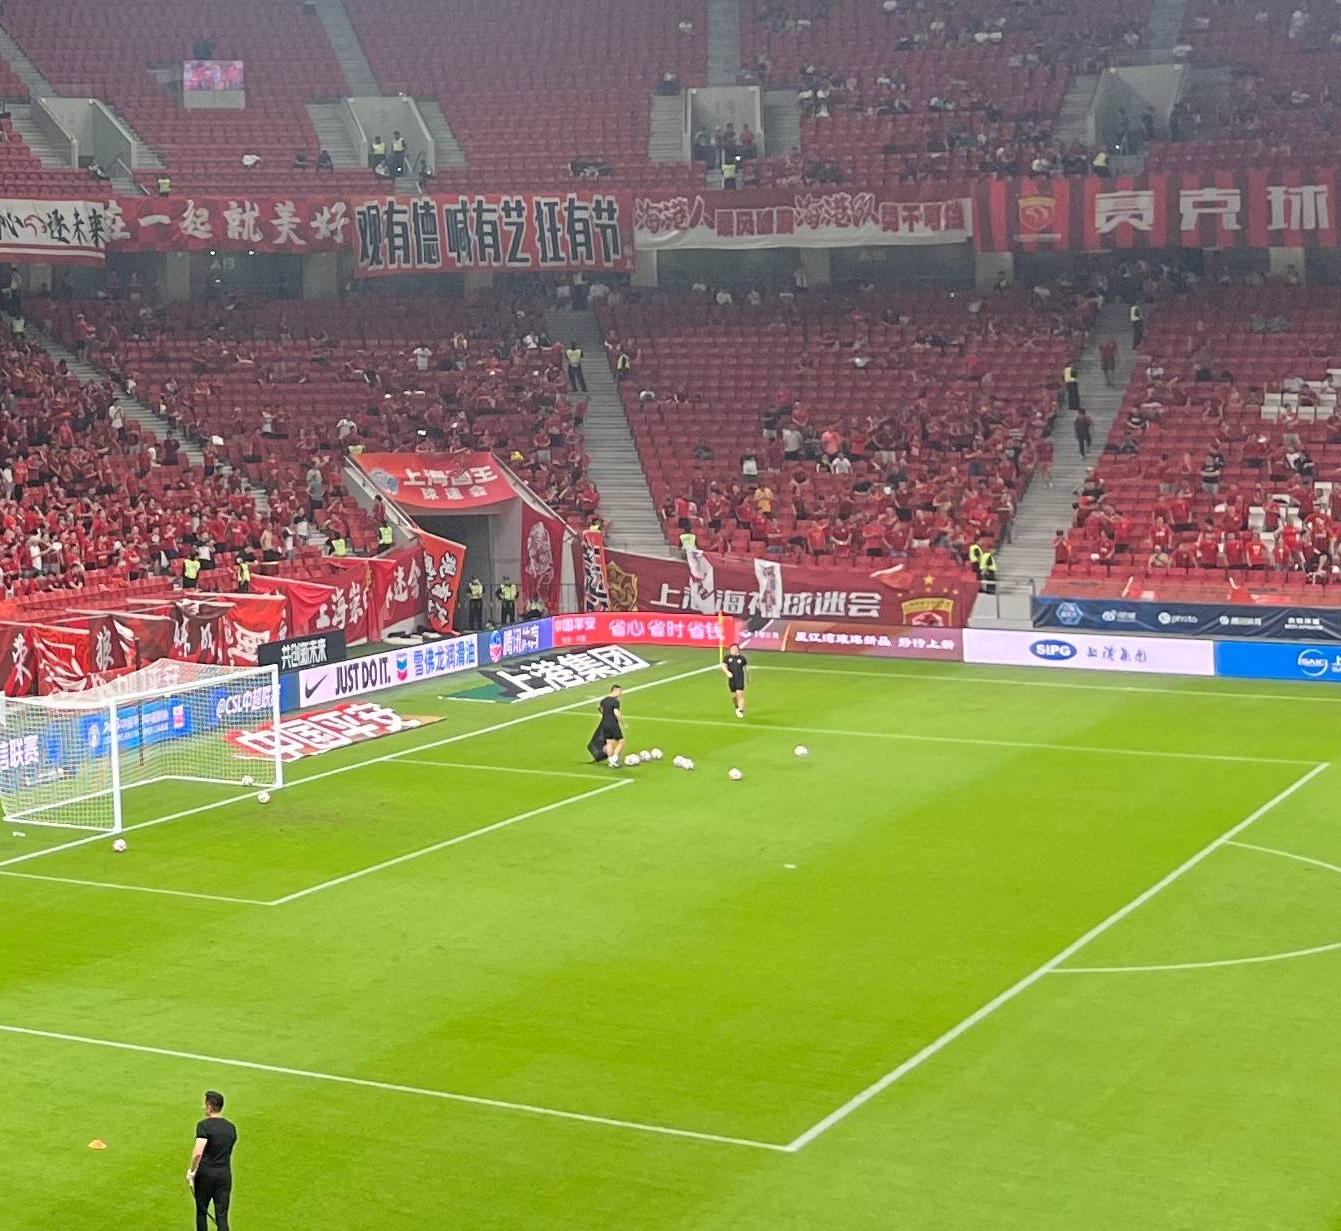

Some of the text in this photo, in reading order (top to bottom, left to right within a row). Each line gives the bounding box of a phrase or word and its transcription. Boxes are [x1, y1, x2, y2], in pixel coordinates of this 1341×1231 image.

[609, 619, 645, 637] 省心
[647, 619, 685, 638] 省时
[281, 637, 328, 669] 共创新未来
[413, 640, 476, 677] 雪佛龙润滑油
[1036, 644, 1072, 657] SIPG
[335, 662, 361, 695] JUST
[362, 659, 378, 688] DO
[496, 644, 650, 699] 上港集团
